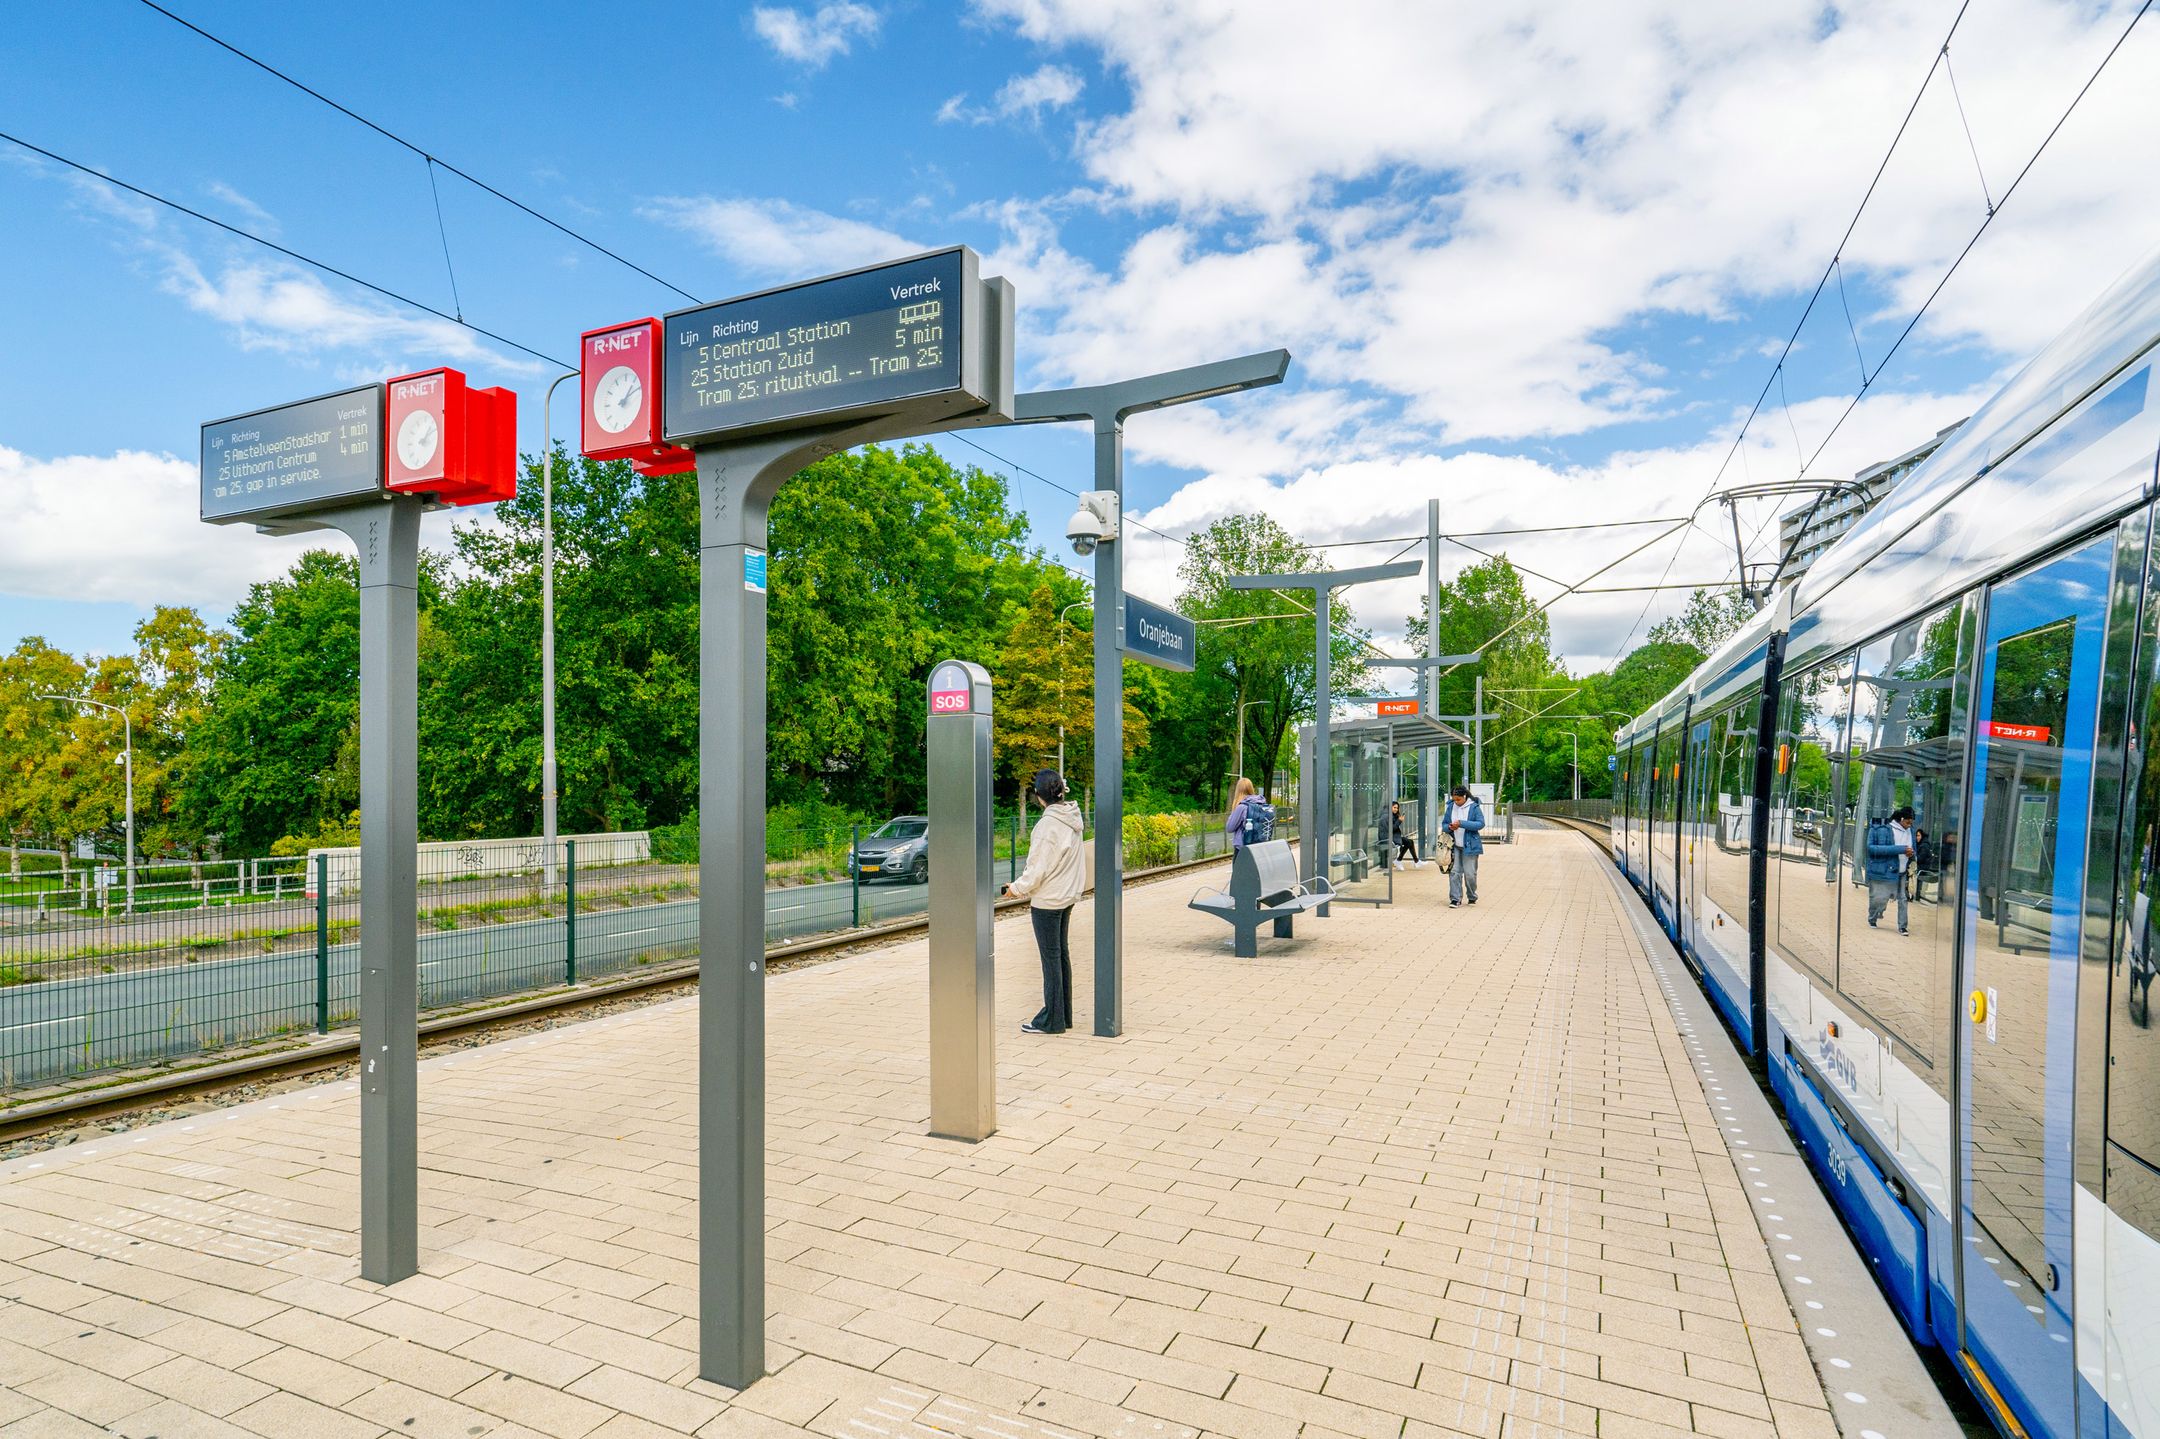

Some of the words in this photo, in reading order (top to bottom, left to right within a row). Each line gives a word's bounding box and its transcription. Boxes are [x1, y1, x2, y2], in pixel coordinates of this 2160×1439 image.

[680, 330, 699, 348] Lijn
[712, 319, 759, 338] Richting
[890, 277, 941, 300] Vertrek
[691, 367, 709, 387] 25
[713, 358, 772, 383] Station
[778, 347, 814, 371] Zuid
[895, 328, 906, 348] 5
[913, 324, 942, 344] min
[699, 346, 709, 364] 5
[712, 331, 782, 361] Centraal
[787, 321, 850, 346] Station
[697, 388, 732, 407] Tram
[737, 380, 760, 400] 25:
[765, 365, 843, 395] rituitval.
[869, 356, 909, 376] Tram
[917, 346, 942, 368] 25:
[211, 437, 224, 450] Lijn
[231, 430, 260, 444] Richting
[337, 405, 367, 421] Vertrek
[224, 450, 231, 464] 5
[340, 425, 347, 439] 1
[350, 422, 368, 437] min
[219, 466, 231, 481] 25
[232, 460, 274, 478] Uithoorn
[277, 451, 317, 469] Centrum
[340, 442, 347, 456] 4
[351, 439, 369, 455] min
[267, 475, 277, 488] in
[1139, 618, 1183, 651] Oranjebaan
[936, 695, 965, 709] SOS
[1836, 1047, 1857, 1093] GVB
[1828, 1142, 1846, 1187] 3039
